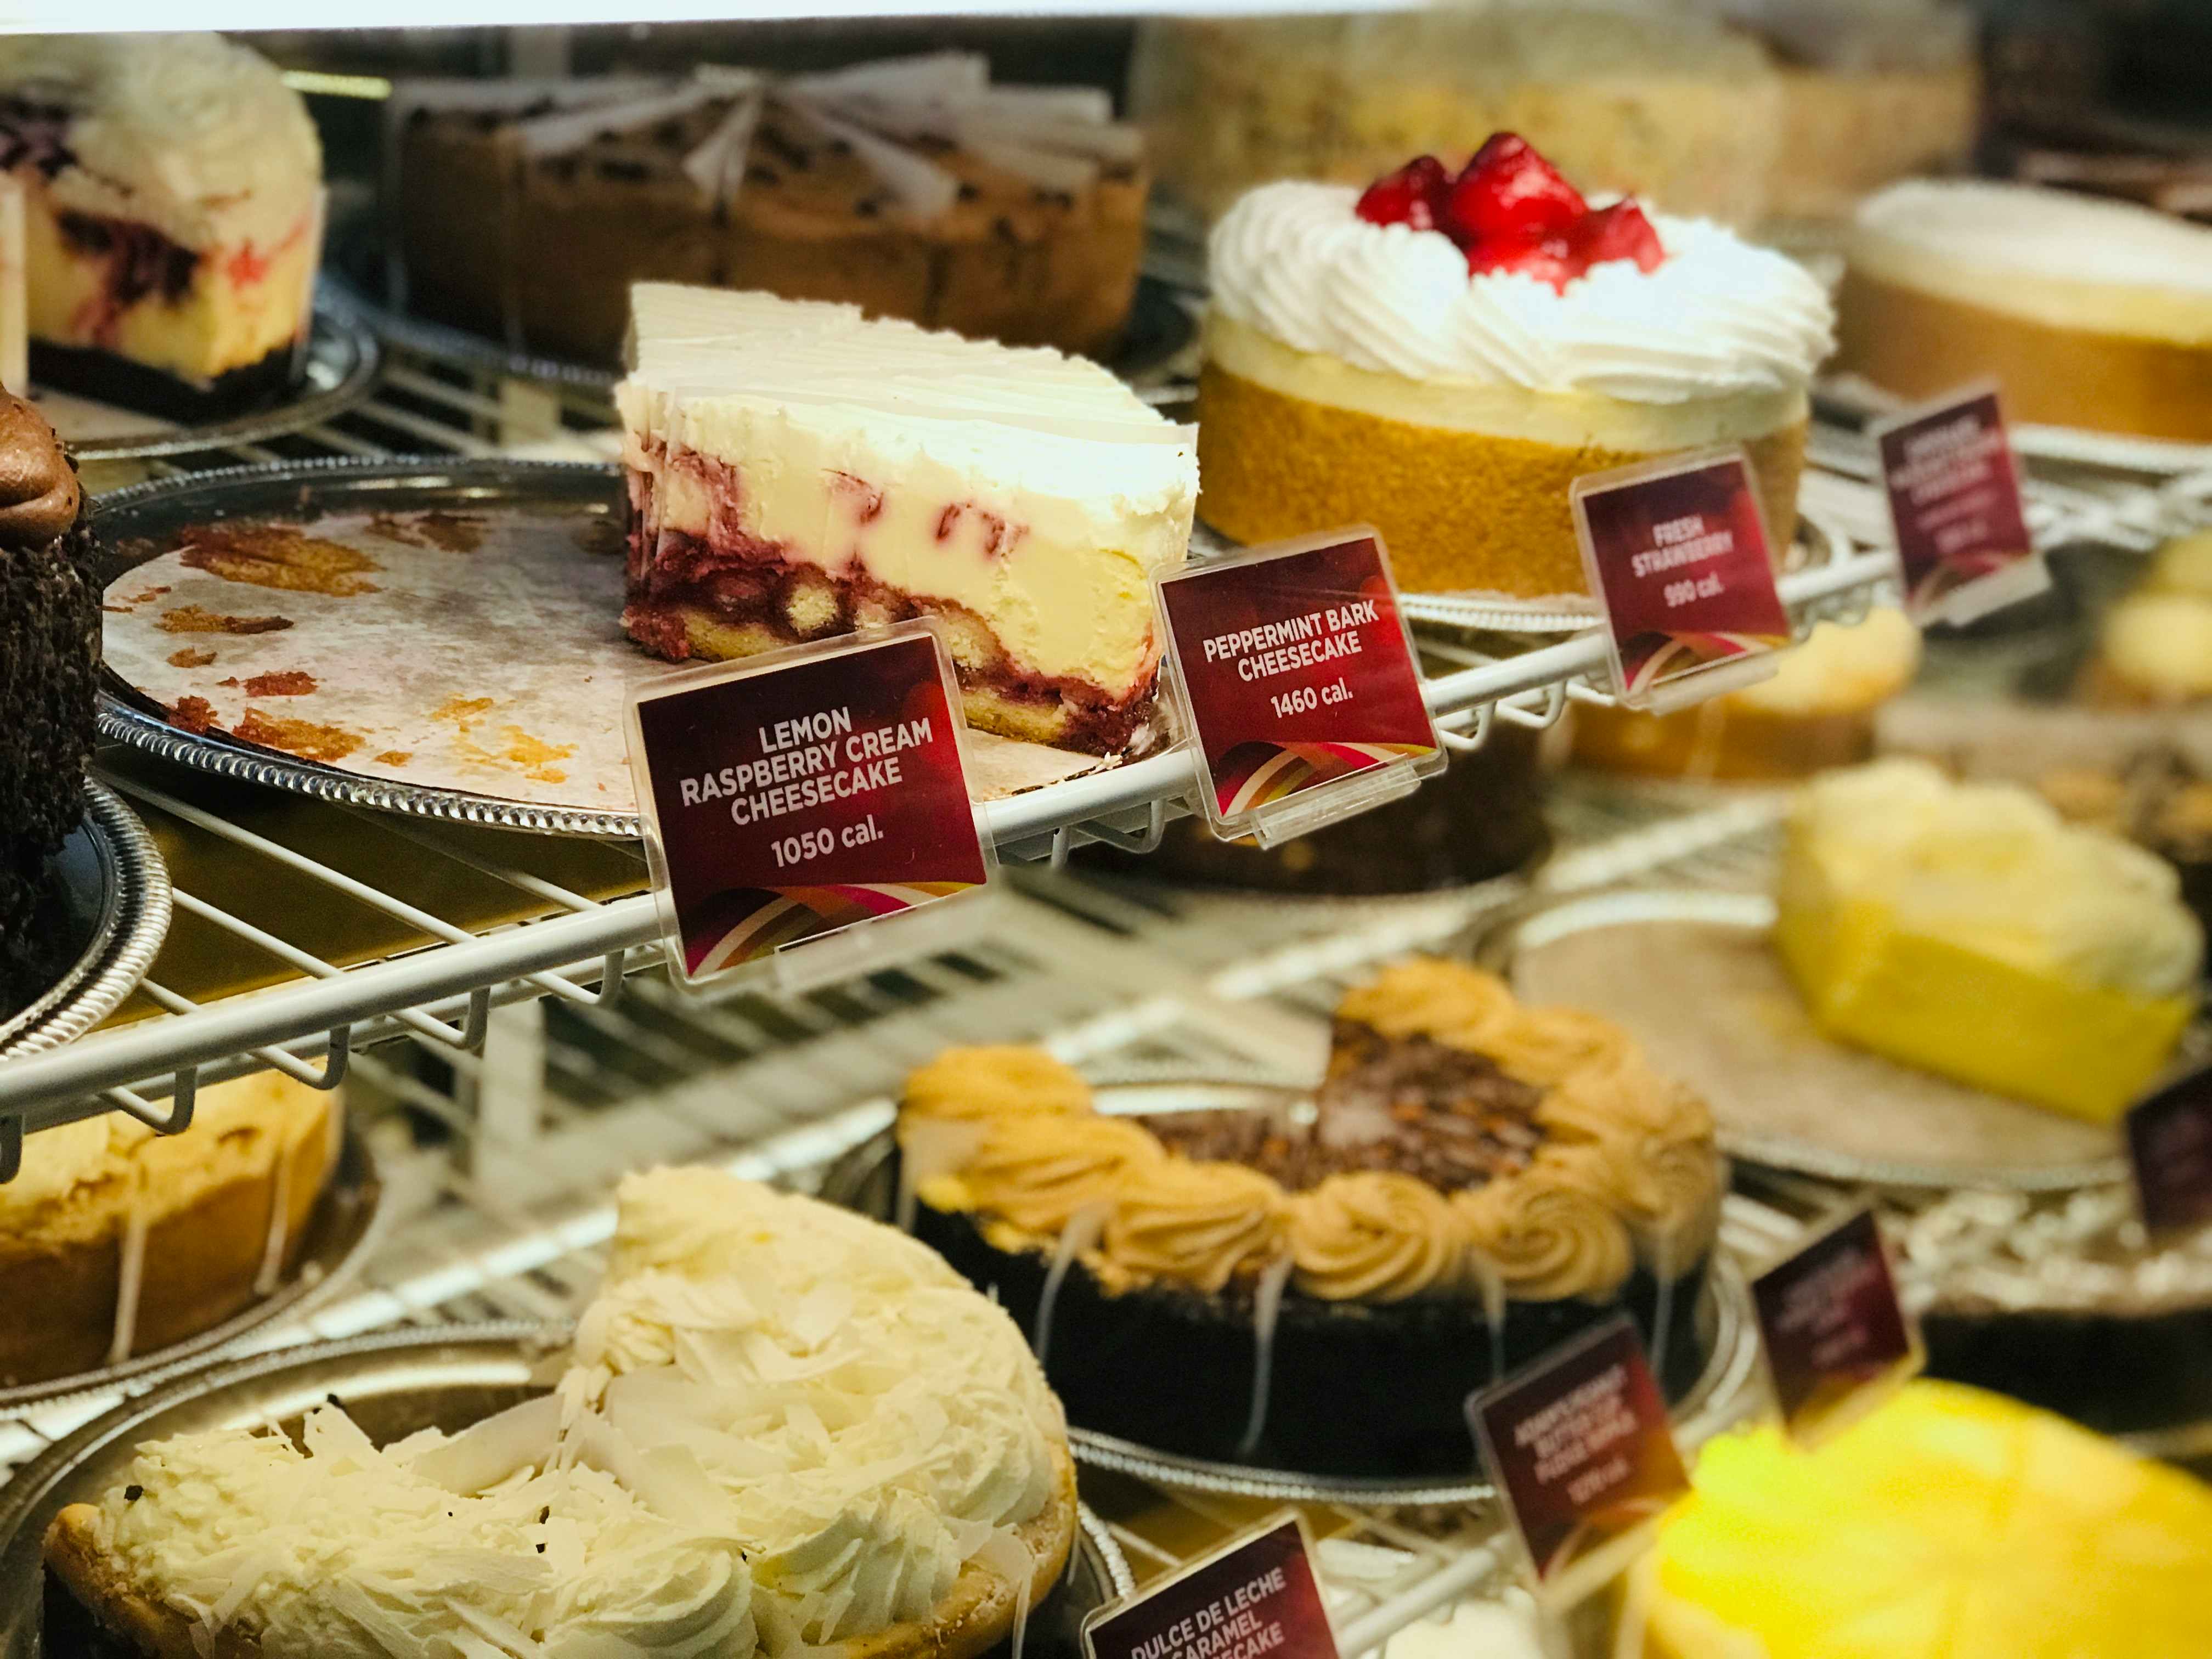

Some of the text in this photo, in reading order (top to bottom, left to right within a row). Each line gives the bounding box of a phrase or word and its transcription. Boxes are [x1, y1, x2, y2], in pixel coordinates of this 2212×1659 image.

[1632, 530, 1734, 578] STRAWBERRY
[1652, 514, 1705, 548] FRESH
[1203, 599, 1379, 663] PEPPERMINT BARK
[1238, 630, 1362, 682] CHEESECAKE
[1271, 677, 1353, 719] 1460 cal.
[759, 707, 851, 753] LEMON
[680, 718, 933, 806] RASPBERRY CREAM
[731, 757, 902, 825] CHEESECAKE
[771, 814, 884, 867] 1050 cal.
[1195, 1601, 1224, 1632] DE
[1224, 1567, 1286, 1617] LECHE
